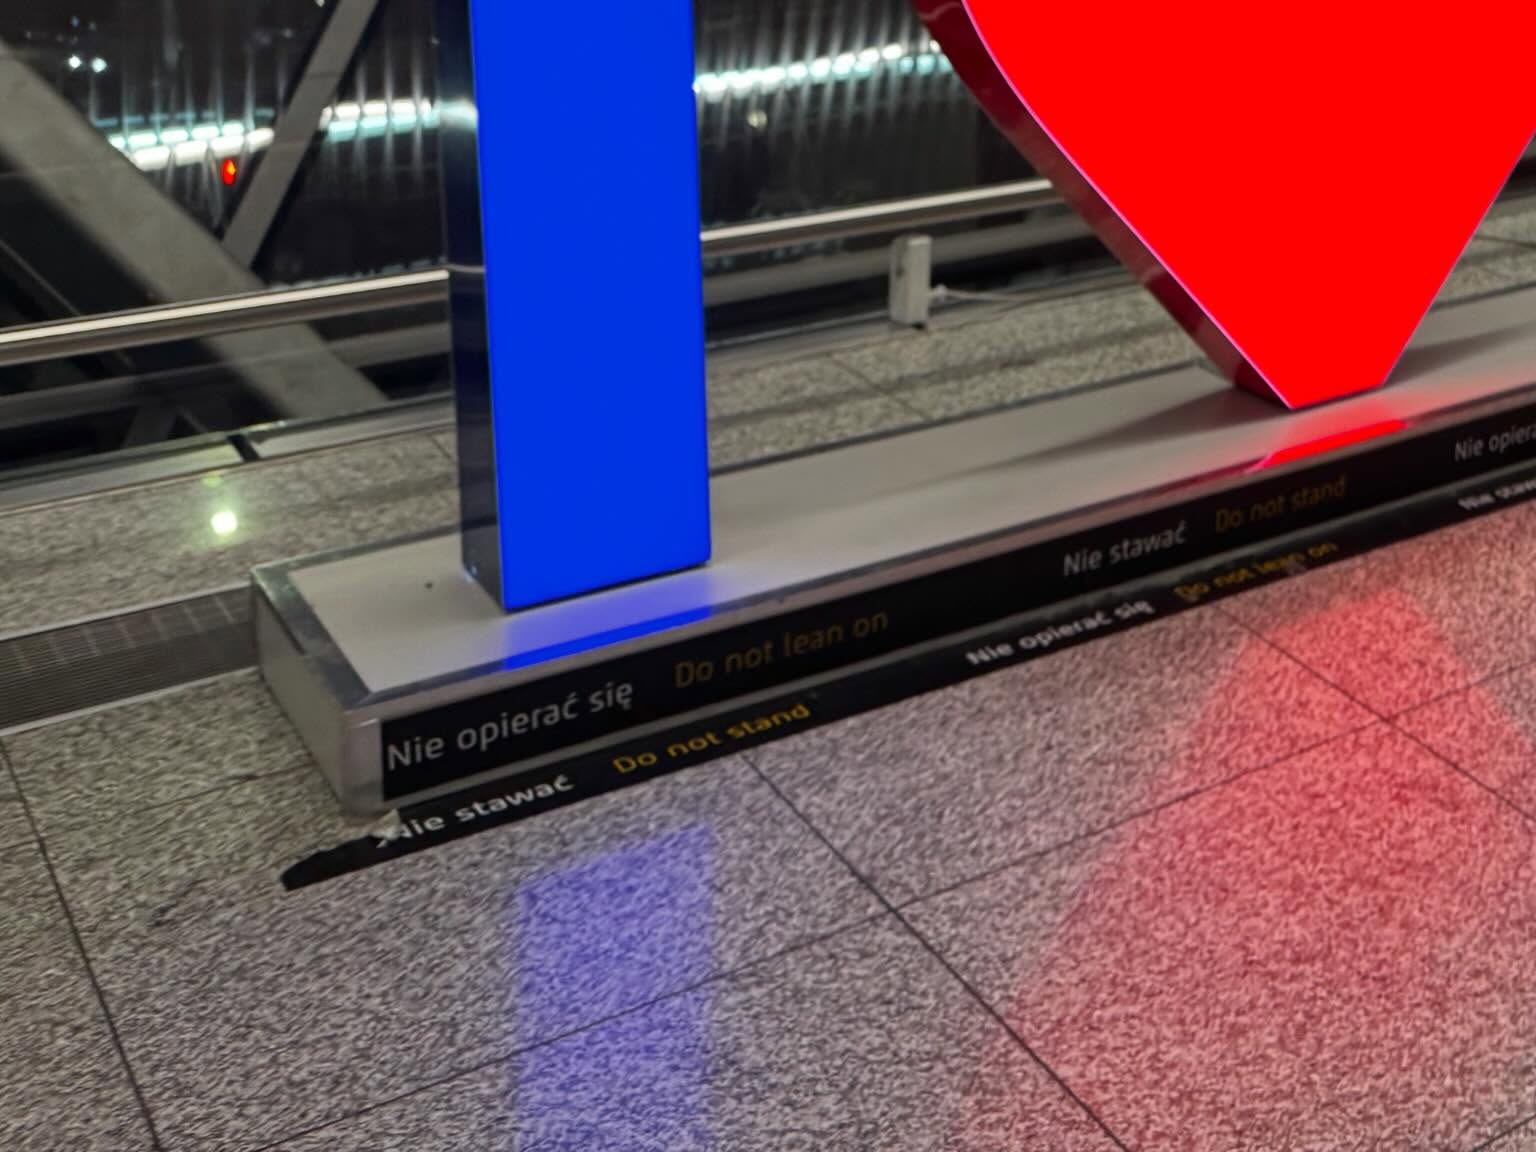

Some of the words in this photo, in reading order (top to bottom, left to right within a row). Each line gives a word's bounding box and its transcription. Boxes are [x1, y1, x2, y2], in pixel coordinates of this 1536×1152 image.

[1453, 435, 1485, 462] Nie
[1215, 507, 1243, 534] Do
[1249, 494, 1286, 521] not
[1290, 472, 1348, 509] stand
[1062, 547, 1103, 577] Nie
[1109, 519, 1187, 565] stawać
[674, 659, 715, 688] Do
[724, 639, 774, 673] not
[783, 623, 844, 656] lean
[852, 611, 889, 638] on
[965, 642, 1015, 665] Nie
[1017, 609, 1113, 649] opierać
[386, 735, 446, 771] Nie
[455, 691, 579, 752] opierać
[588, 679, 634, 712] się
[611, 750, 658, 774] Do
[666, 729, 723, 759] not
[725, 703, 813, 739] stand
[453, 774, 576, 823] stawać
